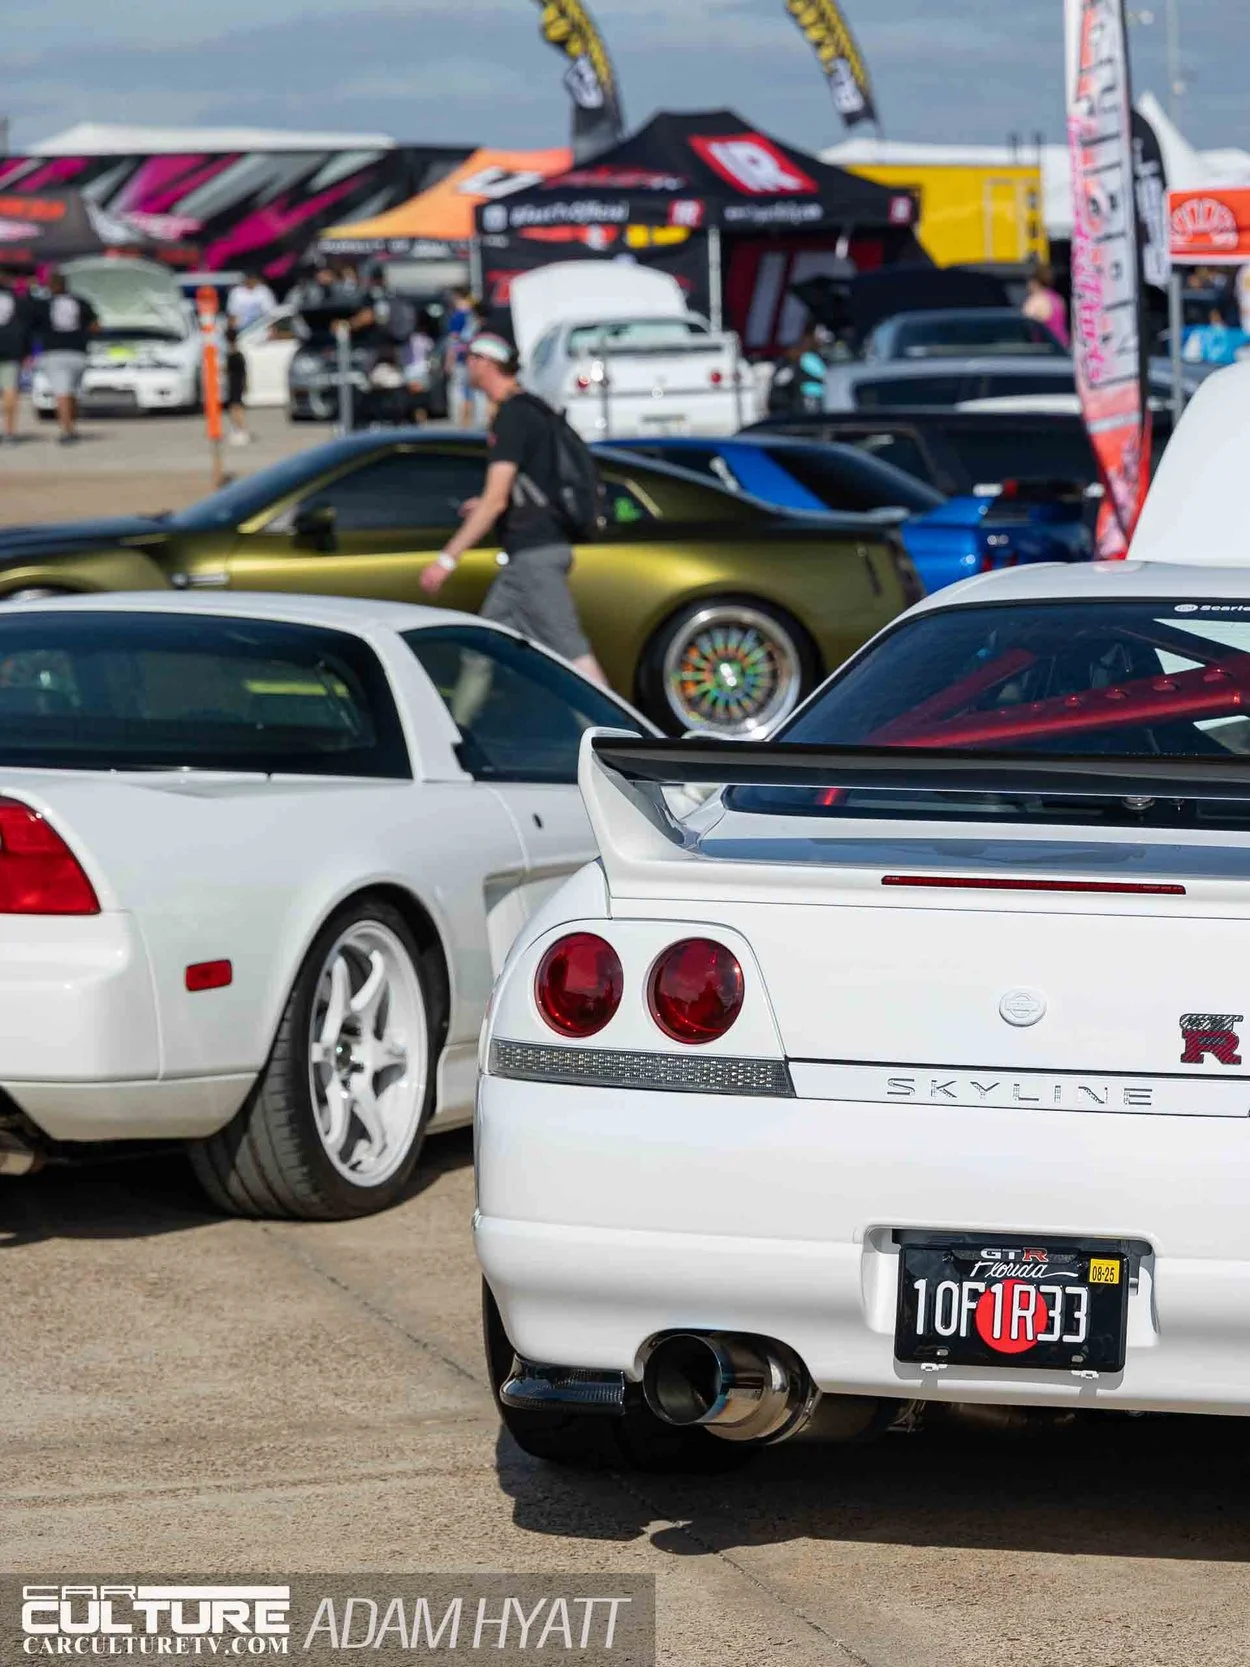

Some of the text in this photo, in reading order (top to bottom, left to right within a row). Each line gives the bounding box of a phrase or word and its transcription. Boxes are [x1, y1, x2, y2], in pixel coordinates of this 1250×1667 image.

[886, 1077, 1153, 1106] SKYLINE
[969, 1260, 1078, 1279] Florida
[1092, 1265, 1115, 1283] 08-25
